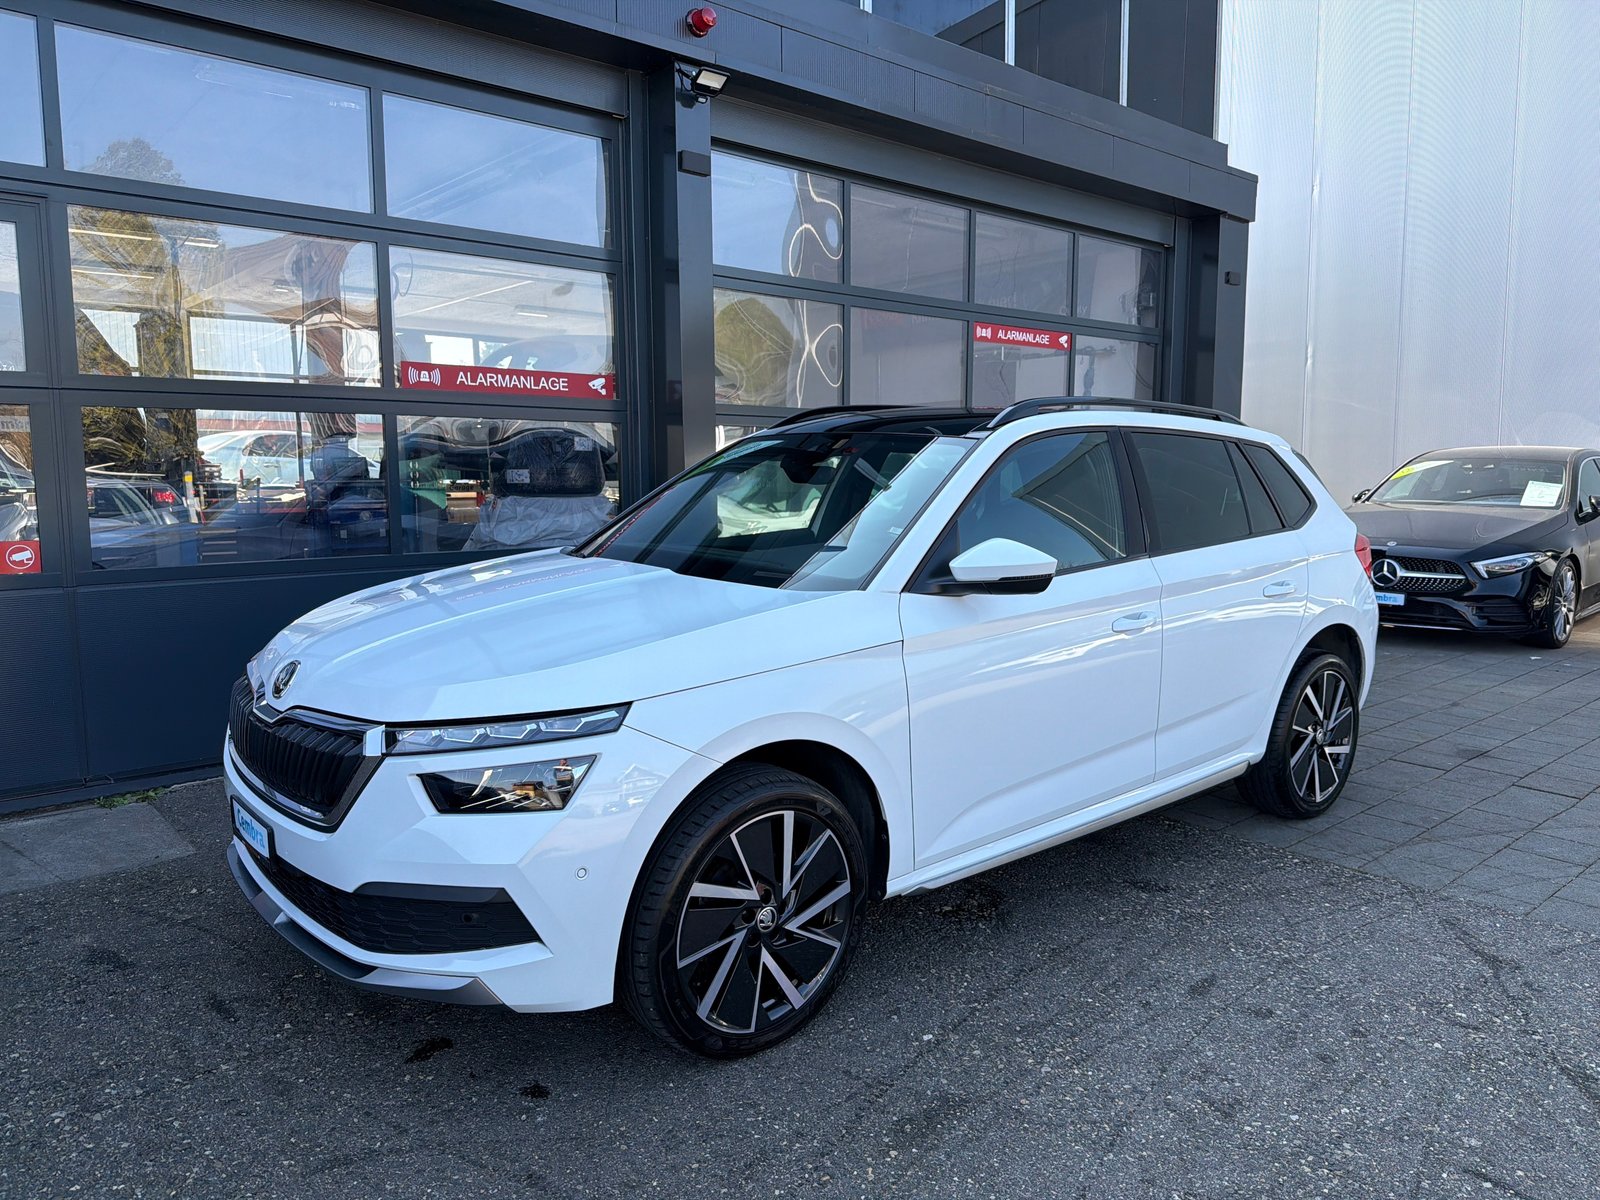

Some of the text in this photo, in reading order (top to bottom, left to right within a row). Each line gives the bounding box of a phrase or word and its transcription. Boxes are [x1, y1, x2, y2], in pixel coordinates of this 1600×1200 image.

[997, 329, 1050, 345] ALARMANLAGE
[456, 371, 569, 391] ALARMANLAGE
[1376, 594, 1398, 602] mbra
[237, 808, 266, 849] Cembra
